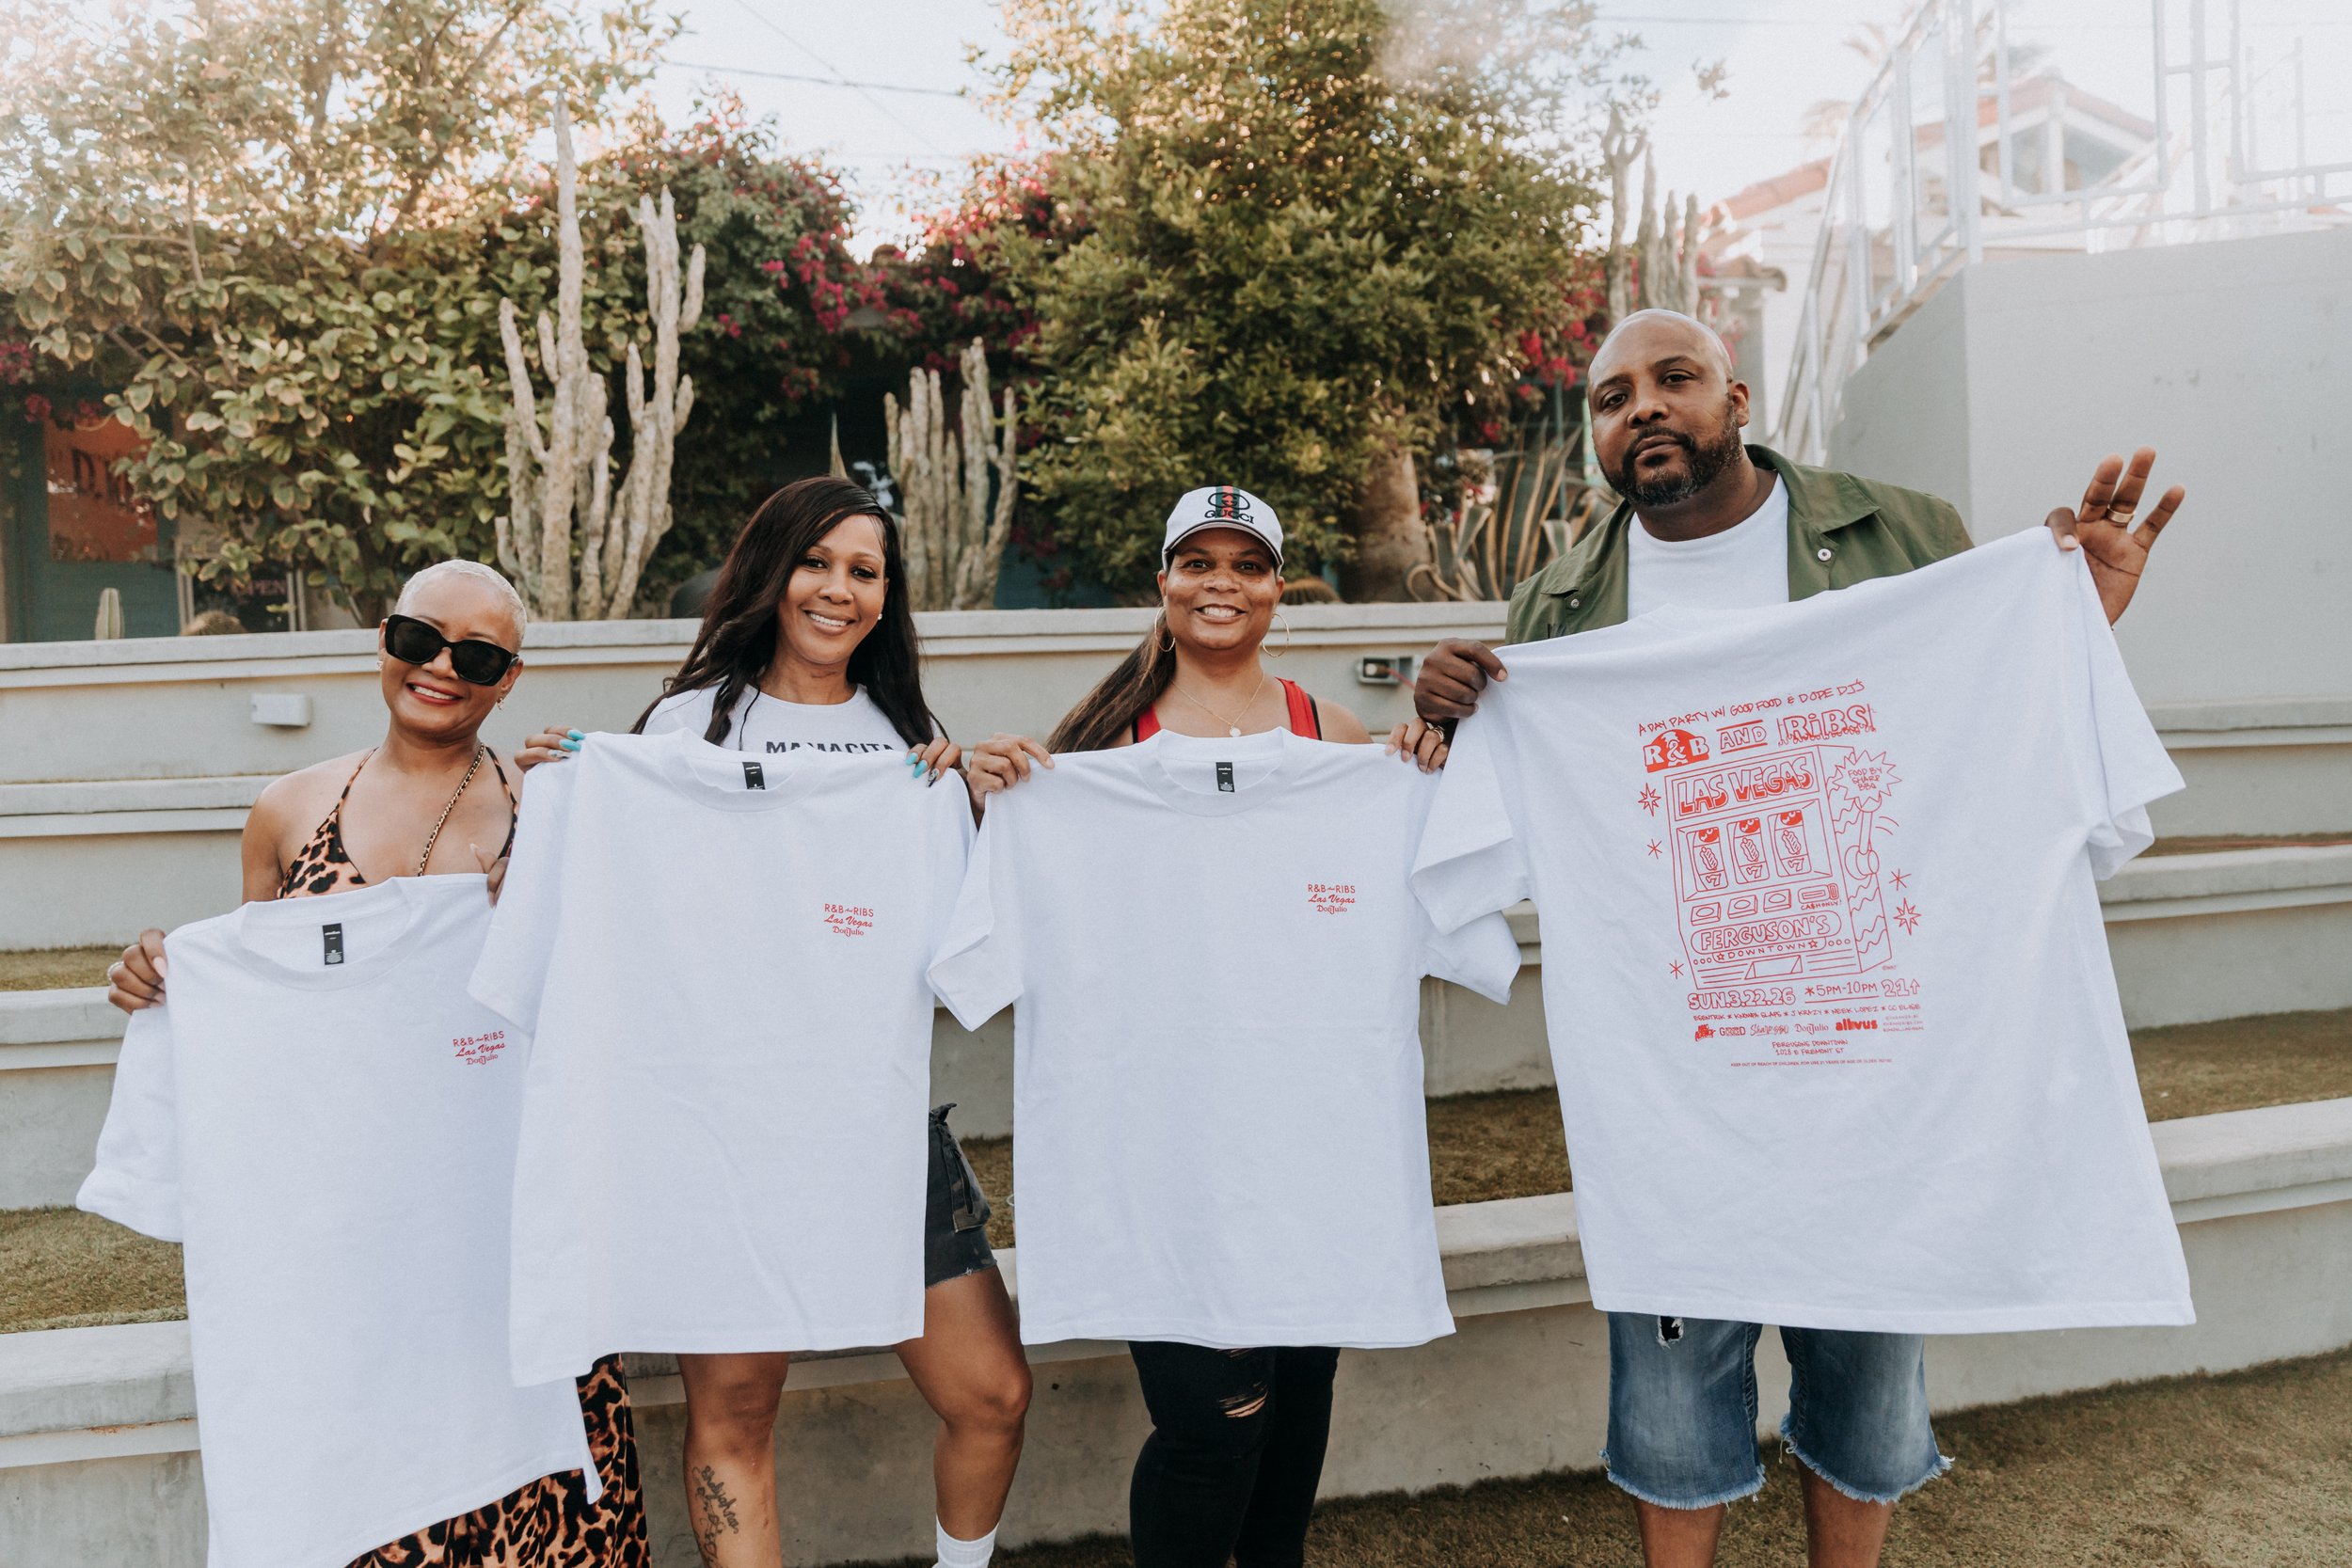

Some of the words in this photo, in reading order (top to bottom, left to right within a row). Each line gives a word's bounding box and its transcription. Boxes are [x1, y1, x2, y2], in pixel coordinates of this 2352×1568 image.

[1204, 510, 1254, 524] GUCCI
[1638, 723, 1646, 736] A
[1647, 720, 1667, 732] DAY
[1668, 711, 1708, 727] PARTY
[1730, 703, 1754, 716] GOOD
[1756, 698, 1782, 711] FOOD
[1799, 688, 1834, 704] DOPE
[1643, 734, 1709, 768] R&B
[1720, 726, 1767, 750] AND
[1847, 768, 1867, 779] FOOD
[1868, 767, 1883, 775] BY
[1851, 775, 1880, 784] SHARP
[1677, 774, 1728, 816] LAS
[1727, 756, 1814, 801] VEGAS
[1857, 783, 1877, 791] BBQ
[1706, 873, 1721, 887] 7
[1746, 864, 1762, 879] 7
[1788, 857, 1804, 872] 7
[1308, 883, 1326, 893] R&B
[1335, 884, 1356, 894] RIBS
[1308, 894, 1327, 902] Las
[1328, 895, 1356, 905] Vegas
[824, 903, 844, 913] R&B
[853, 907, 874, 917] RIBS
[824, 913, 844, 924] Las
[846, 915, 873, 928] Vegas
[1701, 915, 1831, 950] FERGUSON'S
[1728, 942, 1806, 959] DOWNTOWN
[453, 1037, 474, 1047] R&B
[484, 1030, 504, 1041] RIBS
[1811, 1038, 1849, 1047] DOWNTOWN
[454, 1047, 476, 1057] Las
[478, 1042, 506, 1053] Vegas
